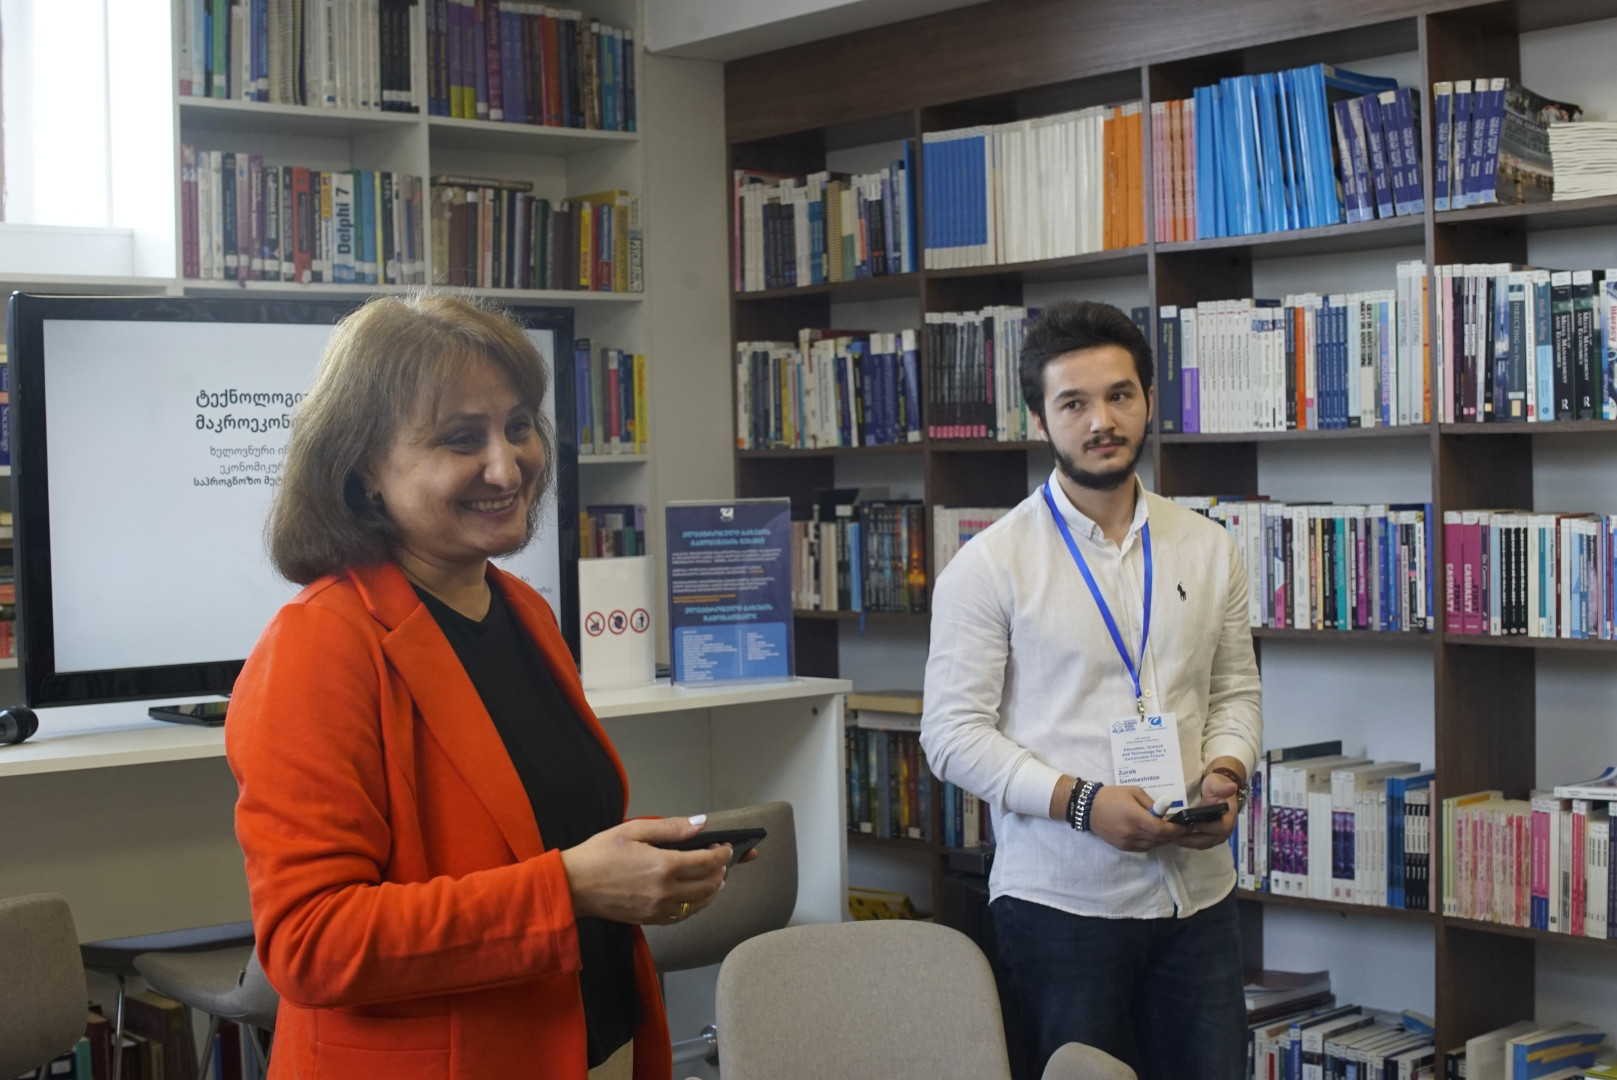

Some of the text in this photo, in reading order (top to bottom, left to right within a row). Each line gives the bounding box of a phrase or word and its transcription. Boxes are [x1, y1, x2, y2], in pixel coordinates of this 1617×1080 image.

[336, 187, 352, 254] Delphi 7
[196, 388, 309, 408] ტექნოლოგი
[196, 414, 294, 433] მაკროეკონ
[210, 445, 275, 458] ხელოვნური
[220, 461, 284, 475] ეკონომიკურ
[194, 476, 262, 488] საპროგნოზო
[1482, 554, 1487, 564] On
[1446, 563, 1454, 612] CASUALTY
[1464, 564, 1472, 613] CASUALTY
[1119, 776, 1160, 784] Gambashidze
